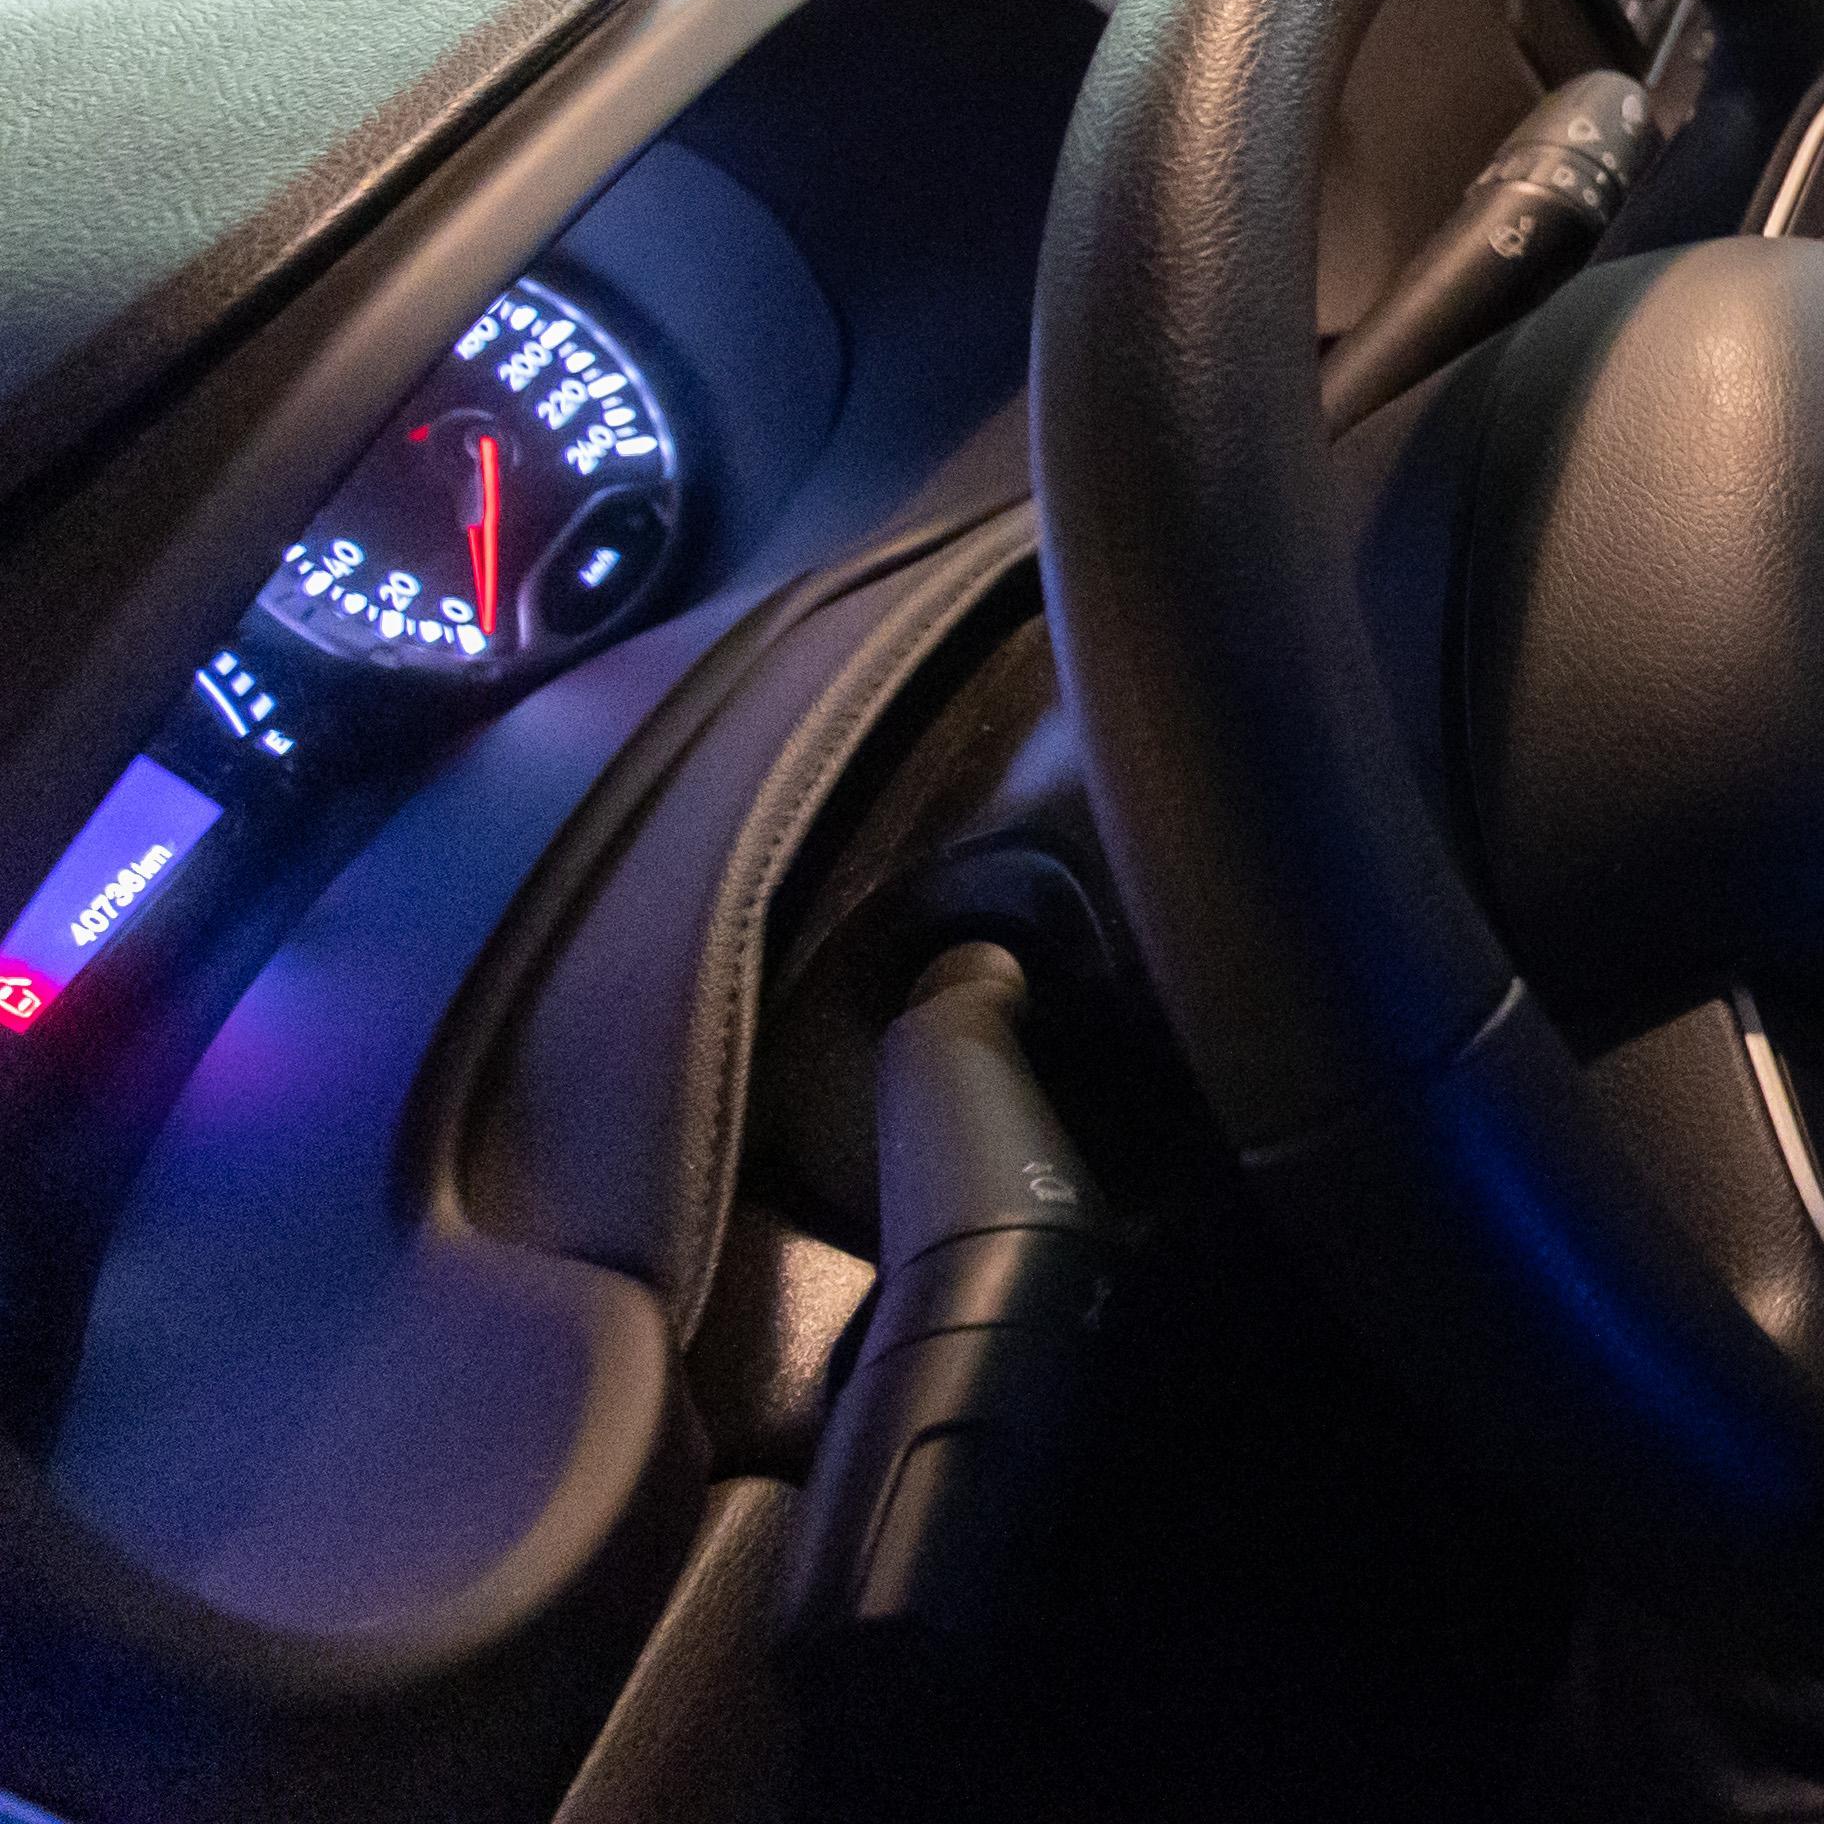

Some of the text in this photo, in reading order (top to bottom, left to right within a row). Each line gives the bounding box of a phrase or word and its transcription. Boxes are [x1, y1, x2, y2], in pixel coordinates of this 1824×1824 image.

[496, 341, 552, 392] 200
[535, 378, 589, 430] 220
[323, 538, 364, 578] 40
[379, 570, 421, 611] 20
[440, 596, 473, 624] 0
[263, 729, 295, 755] E
